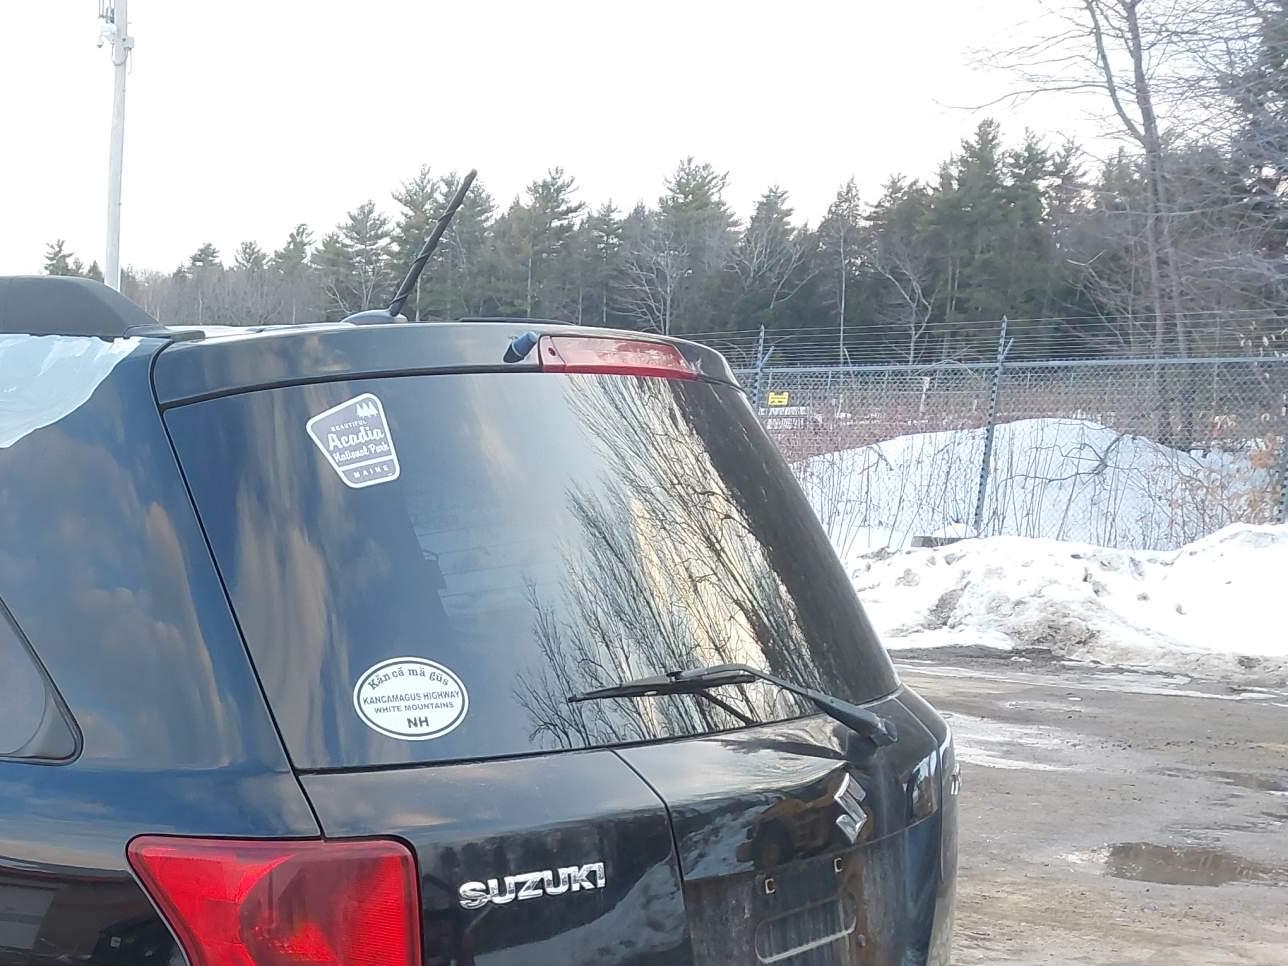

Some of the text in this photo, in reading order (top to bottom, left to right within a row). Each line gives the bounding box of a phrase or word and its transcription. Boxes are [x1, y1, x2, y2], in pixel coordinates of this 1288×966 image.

[327, 426, 385, 451] Acadia
[332, 442, 390, 463] National Park
[353, 465, 390, 478] MAINE
[362, 690, 460, 705] KANCAMAGUS HIGHWAY
[374, 701, 455, 714] WHITE MOUNTAINS
[407, 716, 430, 728] NH
[459, 862, 606, 910] SUZUKI
